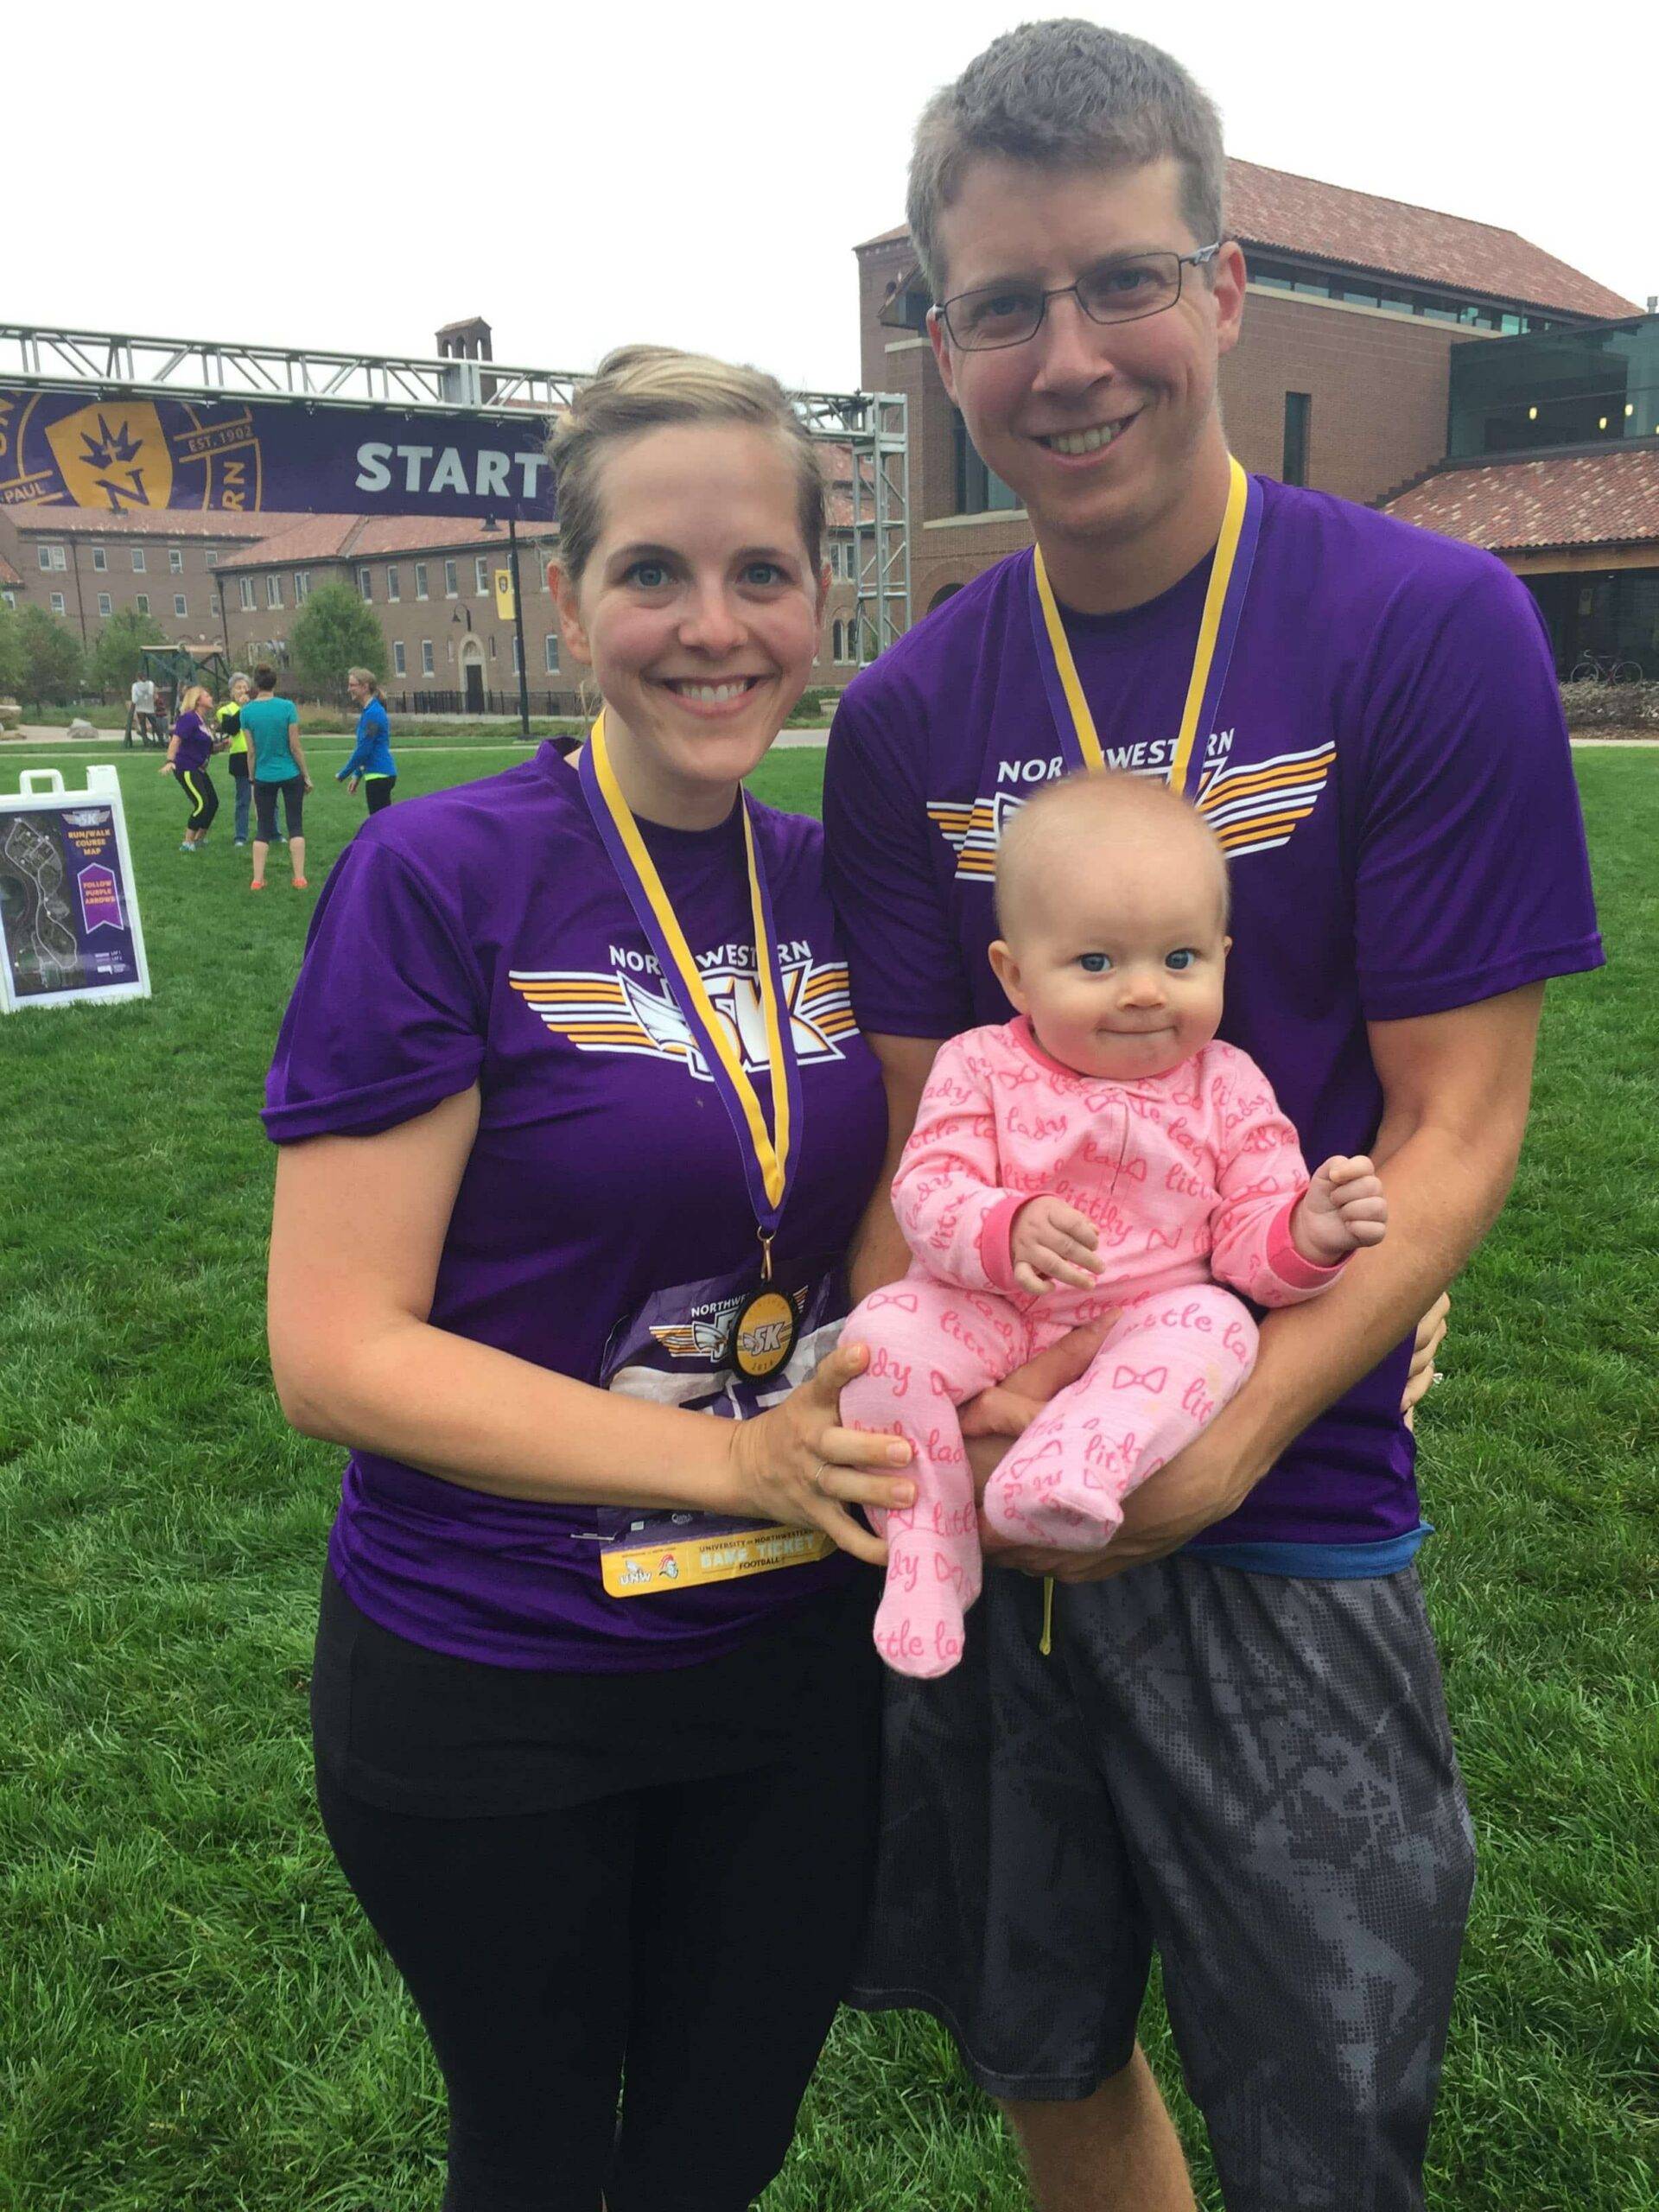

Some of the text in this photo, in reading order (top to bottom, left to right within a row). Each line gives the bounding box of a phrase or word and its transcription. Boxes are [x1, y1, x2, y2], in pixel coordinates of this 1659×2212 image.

[188, 425, 253, 451] EST. 1902
[355, 442, 549, 499] START
[3, 481, 46, 504] PAUL
[997, 728, 1235, 783] NORWESTRN
[68, 829, 111, 839] RUN/WALK
[75, 838, 106, 848] COURSE
[83, 847, 102, 855] MAP
[83, 880, 112, 889] FOLLOW
[85, 887, 112, 897] PURPLE
[85, 895, 116, 905] ARROWS
[608, 940, 812, 976] NORWESTRN
[924, 1077, 972, 1106] ady
[1006, 1107, 1068, 1142] lady
[749, 1321, 785, 1357] 5K
[867, 1347, 912, 1397] dy
[699, 1539, 746, 1553] UNIVERSITY
[754, 1527, 814, 1544] NORTHWESTERN
[701, 1548, 748, 1570] GAME
[756, 1534, 814, 1558] TICKET
[739, 1557, 780, 1570] FOOTBALL
[887, 1549, 918, 1592] dy
